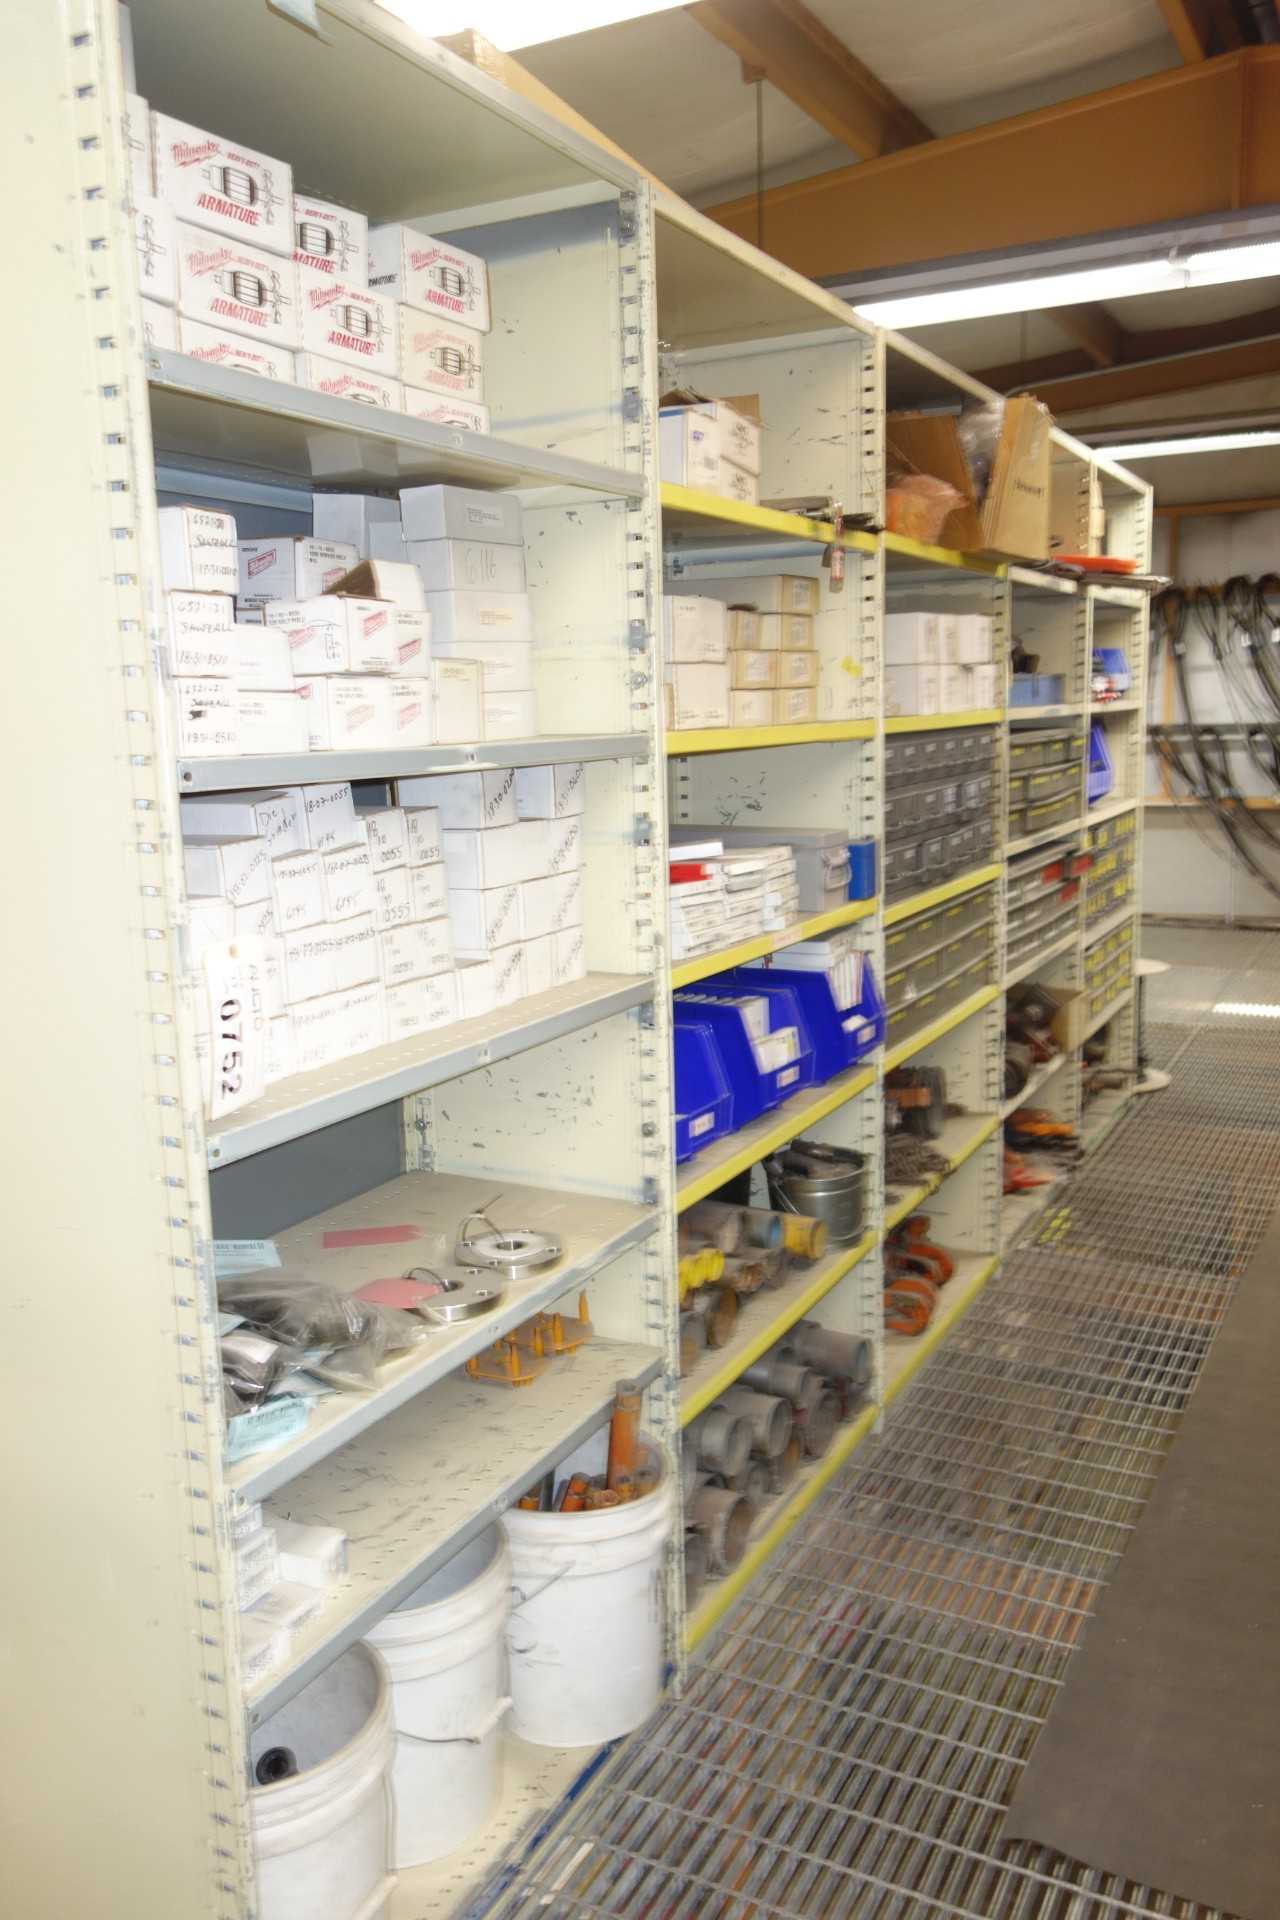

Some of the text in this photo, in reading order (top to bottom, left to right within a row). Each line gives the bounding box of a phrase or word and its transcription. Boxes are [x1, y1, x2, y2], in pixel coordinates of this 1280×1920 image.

[196, 192, 260, 226] ARMATURE
[292, 250, 337, 273] MATURE
[368, 273, 398, 287] RMATURE
[210, 298, 269, 327] ARMATURE
[425, 289, 465, 314] ARMATURE
[328, 330, 377, 356] ARMATURE
[220, 998, 243, 1100] 0752
